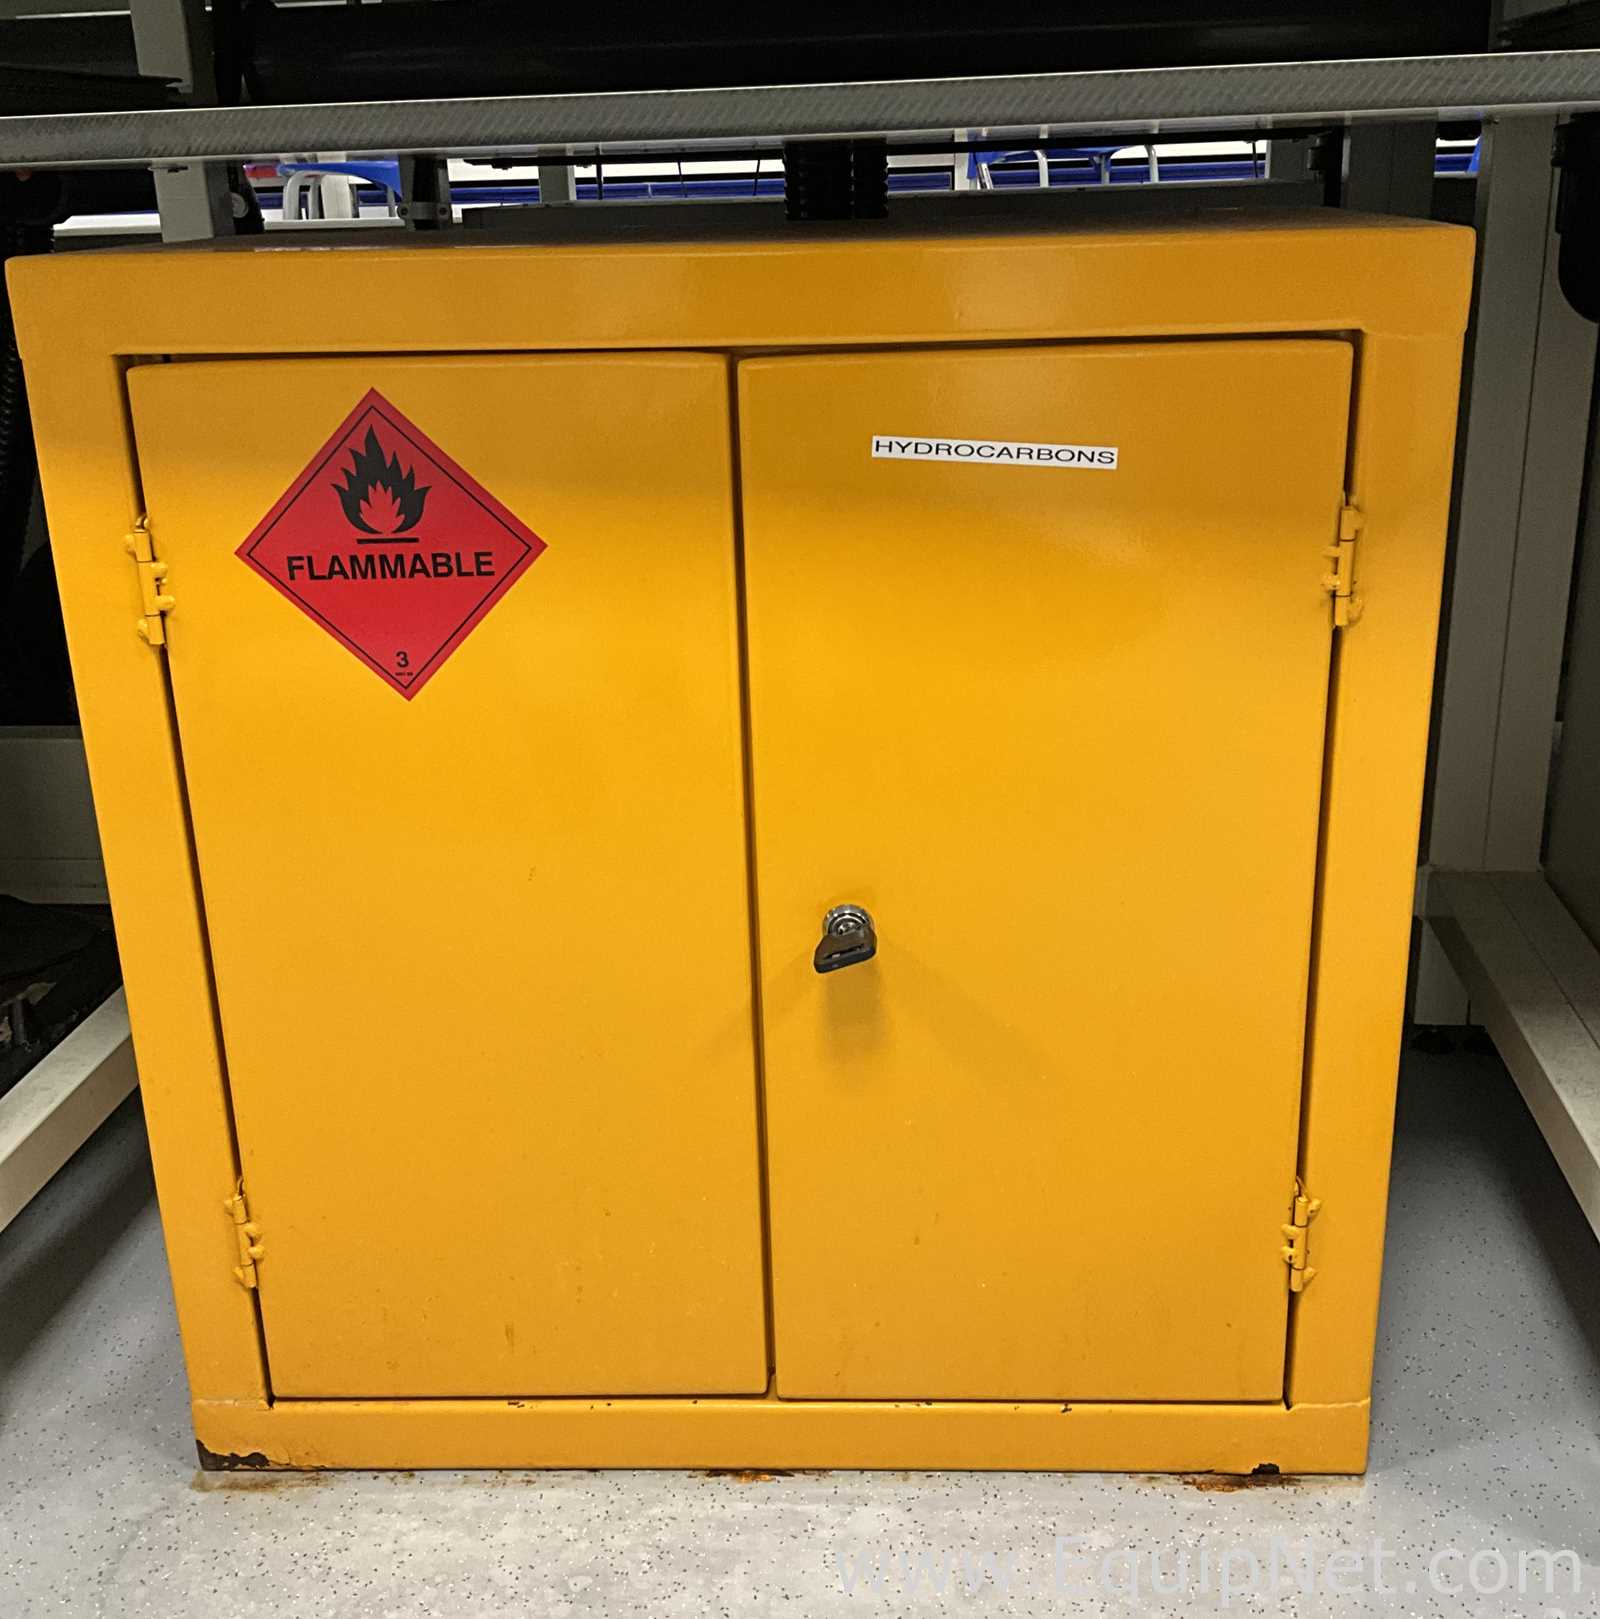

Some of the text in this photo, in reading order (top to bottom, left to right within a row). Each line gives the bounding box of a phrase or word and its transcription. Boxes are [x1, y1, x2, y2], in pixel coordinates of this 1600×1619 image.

[874, 440, 1115, 465] HYDROCARBONS
[286, 552, 496, 581] FLAMMABLE
[396, 651, 409, 668] 3
